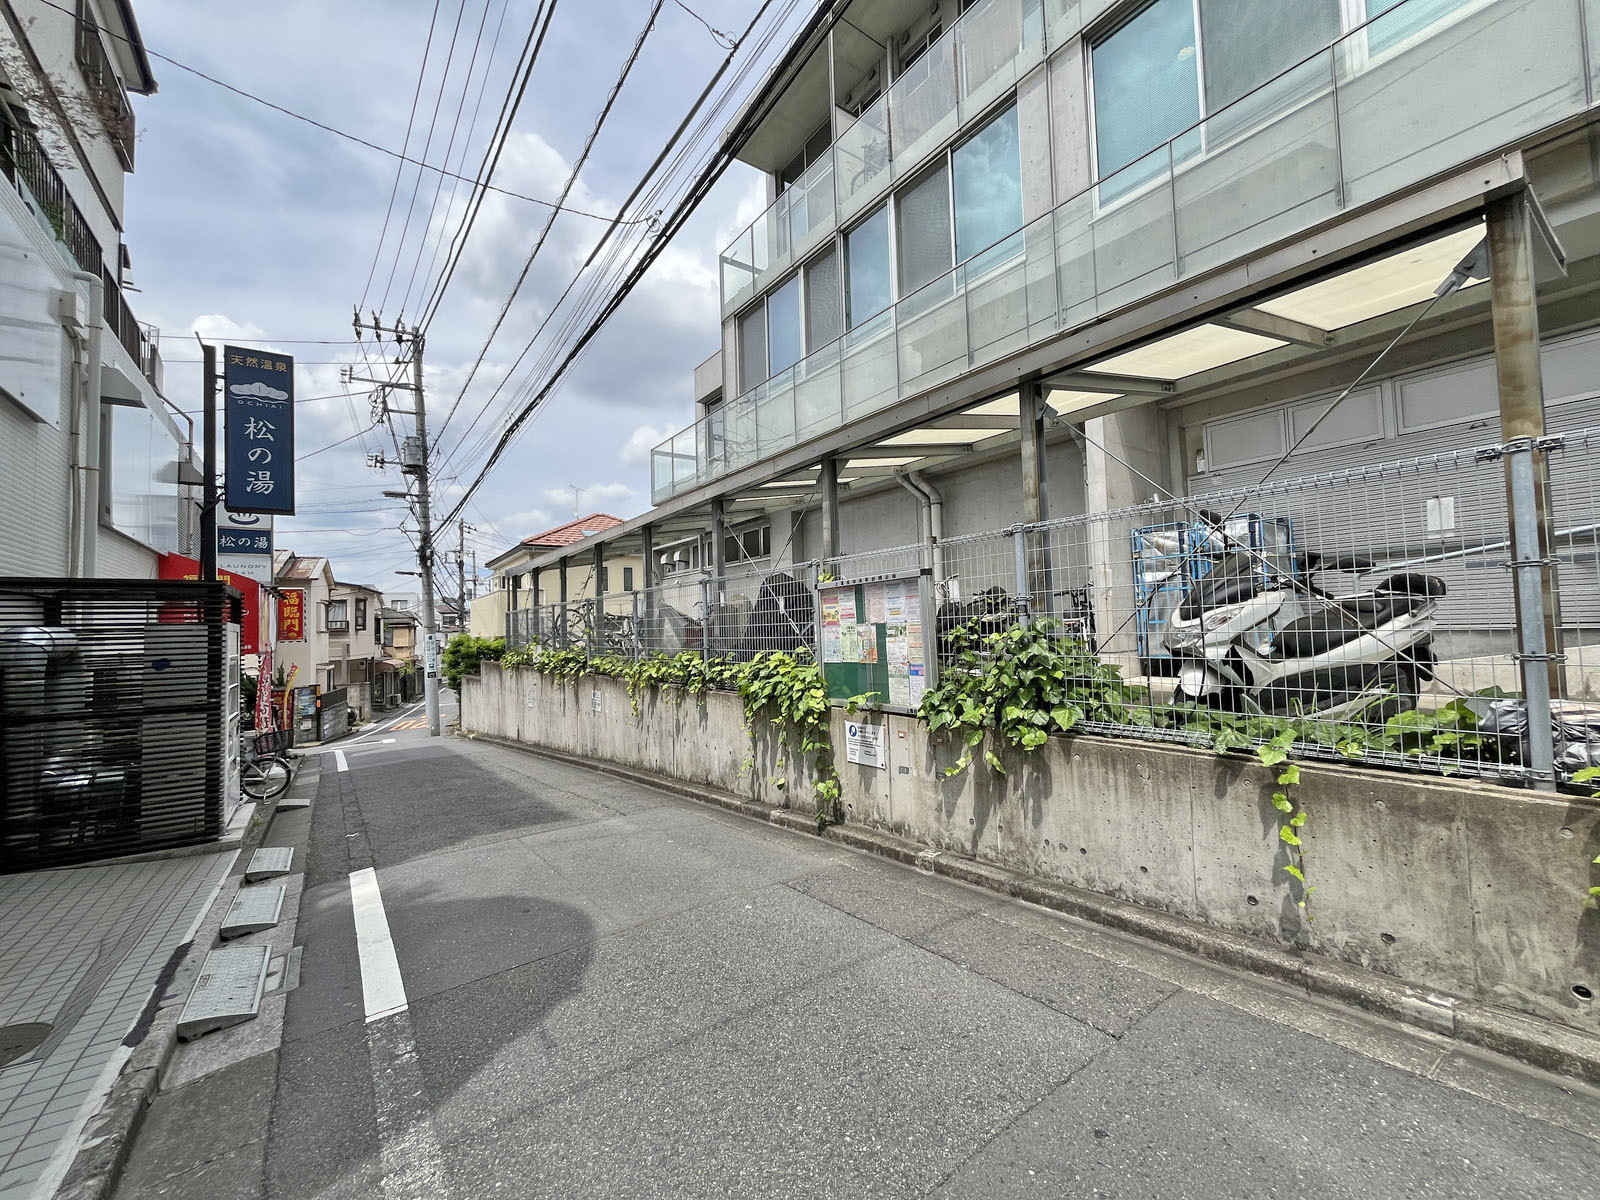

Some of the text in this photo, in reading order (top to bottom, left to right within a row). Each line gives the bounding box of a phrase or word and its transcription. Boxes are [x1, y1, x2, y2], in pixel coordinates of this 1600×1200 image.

[230, 354, 288, 372] 天然温泉
[237, 399, 282, 409] OCHIAI
[244, 416, 276, 495] 松の湯
[219, 535, 269, 549] 松の湯
[283, 592, 300, 631] 福臨門
